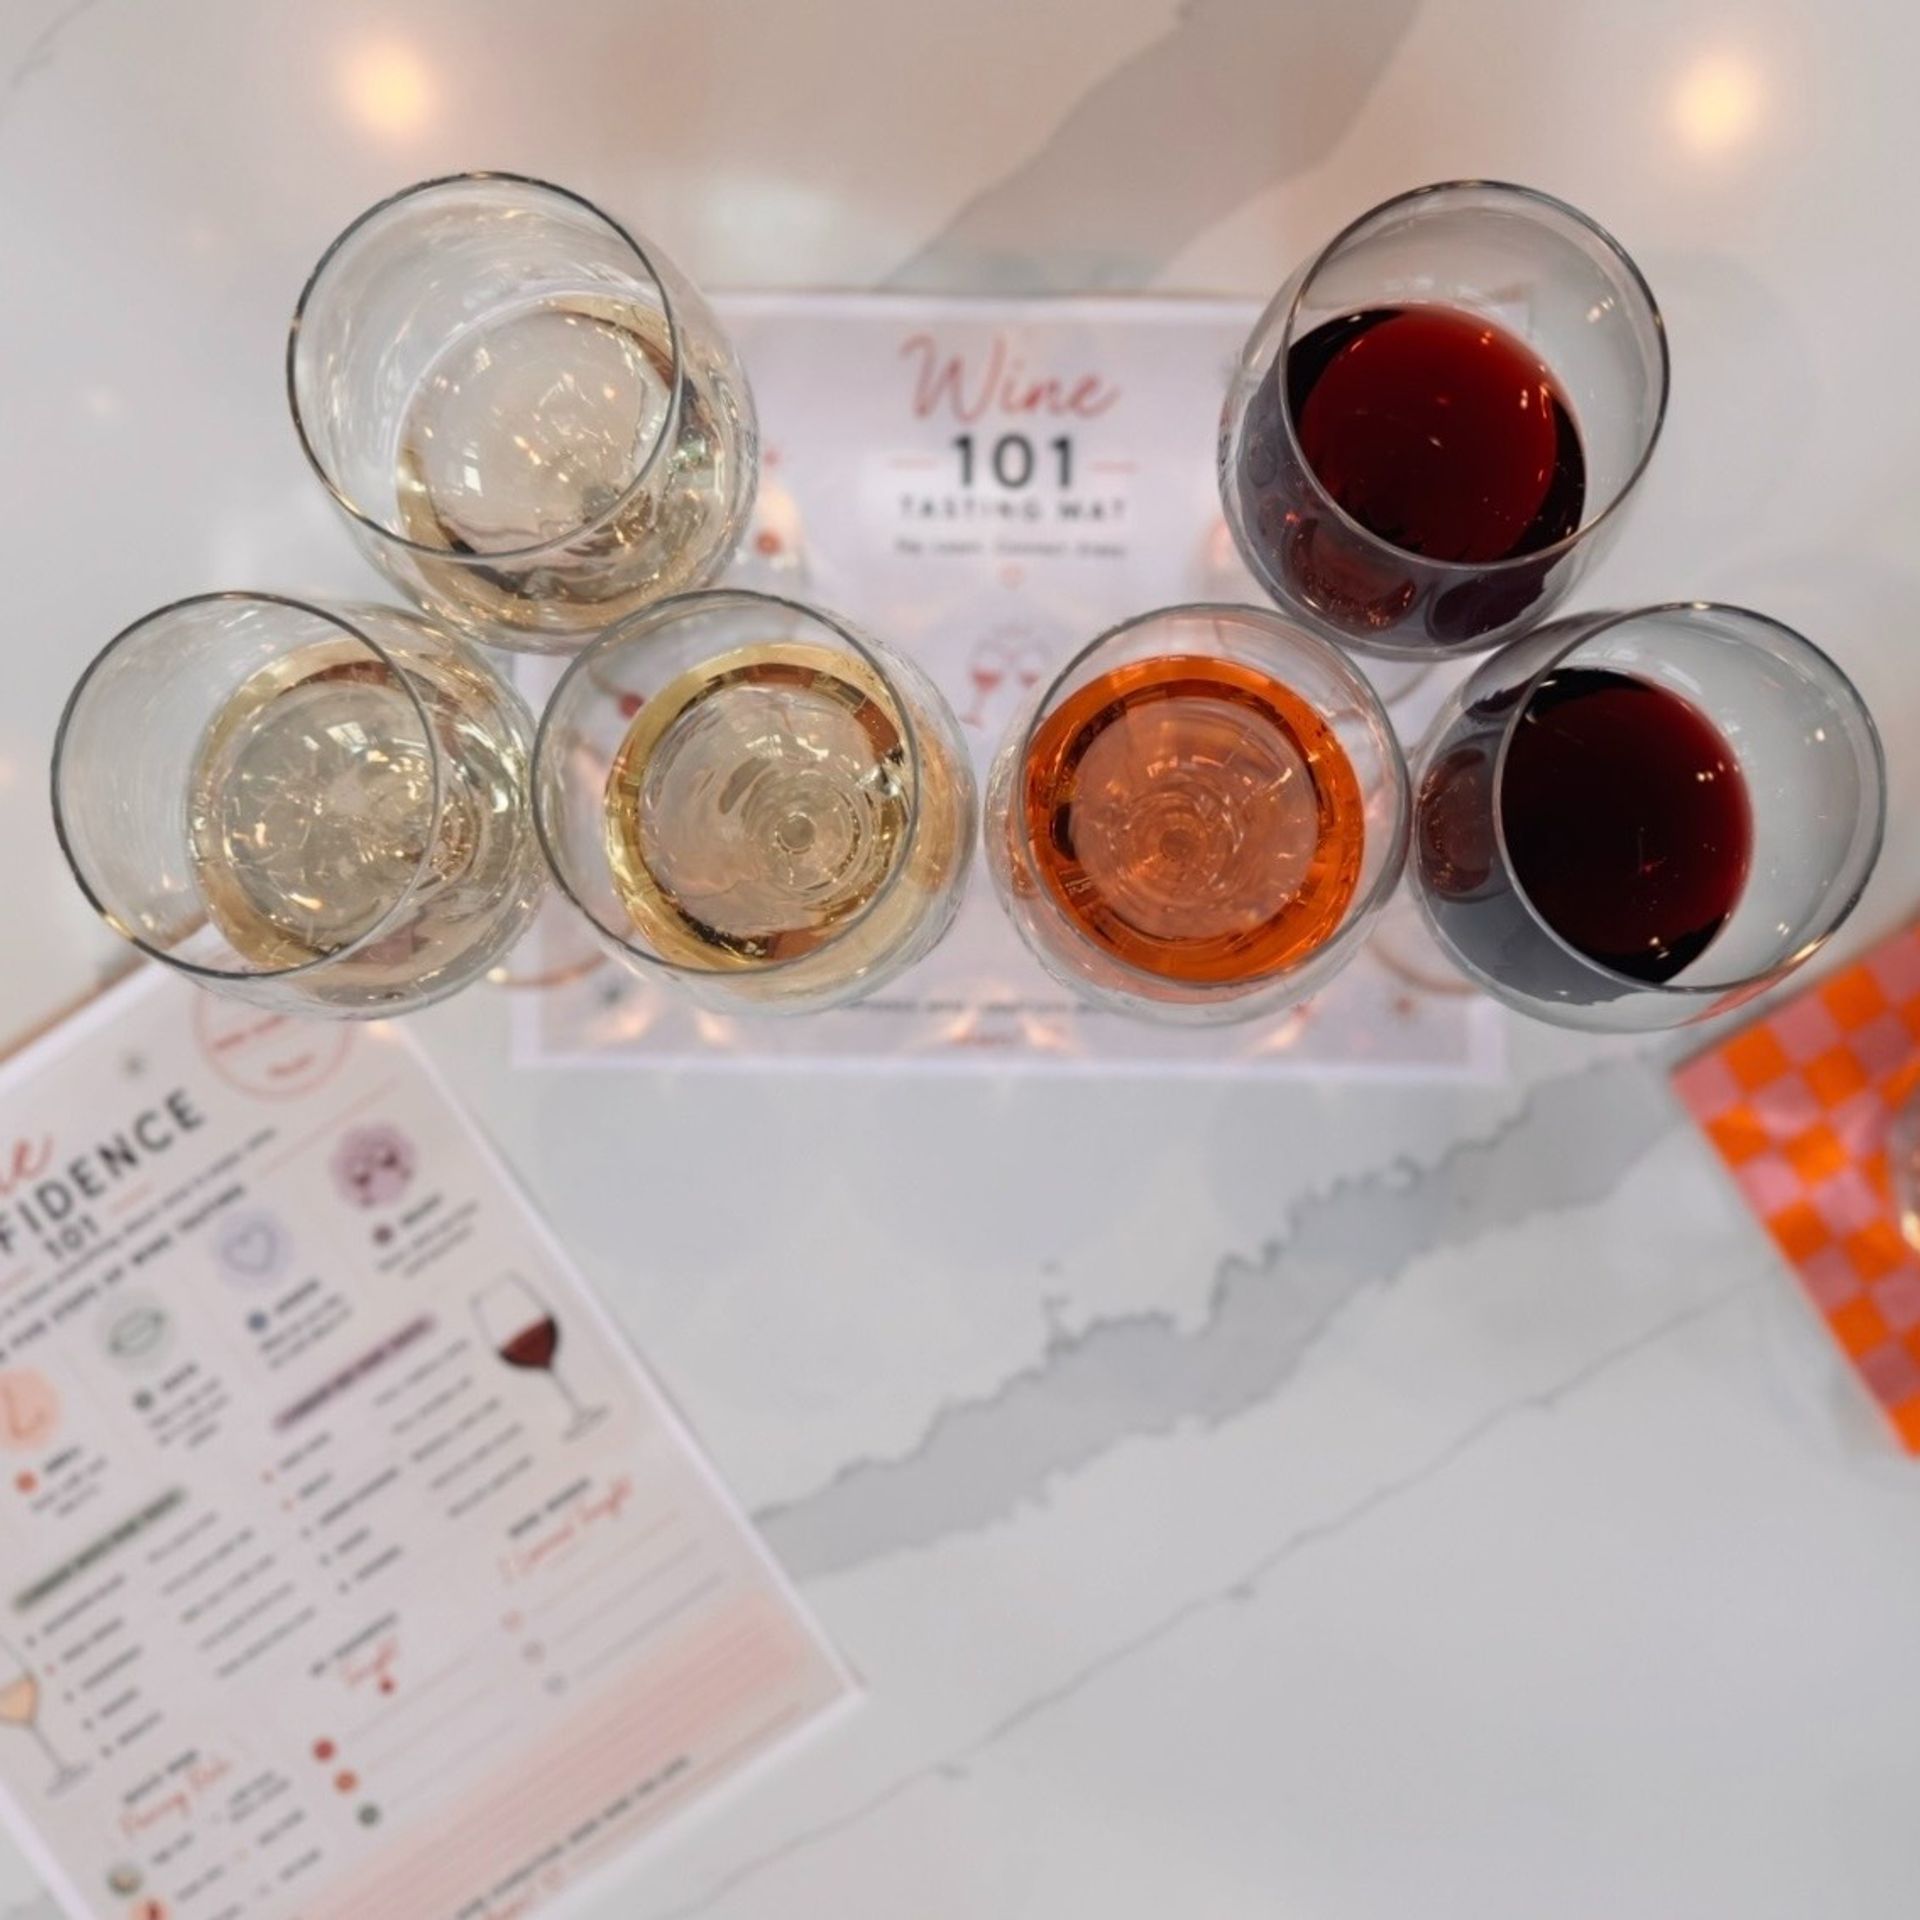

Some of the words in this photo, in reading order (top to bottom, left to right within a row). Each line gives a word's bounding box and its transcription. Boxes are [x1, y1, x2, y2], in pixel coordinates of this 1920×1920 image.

[899, 332, 1121, 425] Wine
[951, 432, 1074, 489] 101
[43, 1214, 102, 1261] 101
